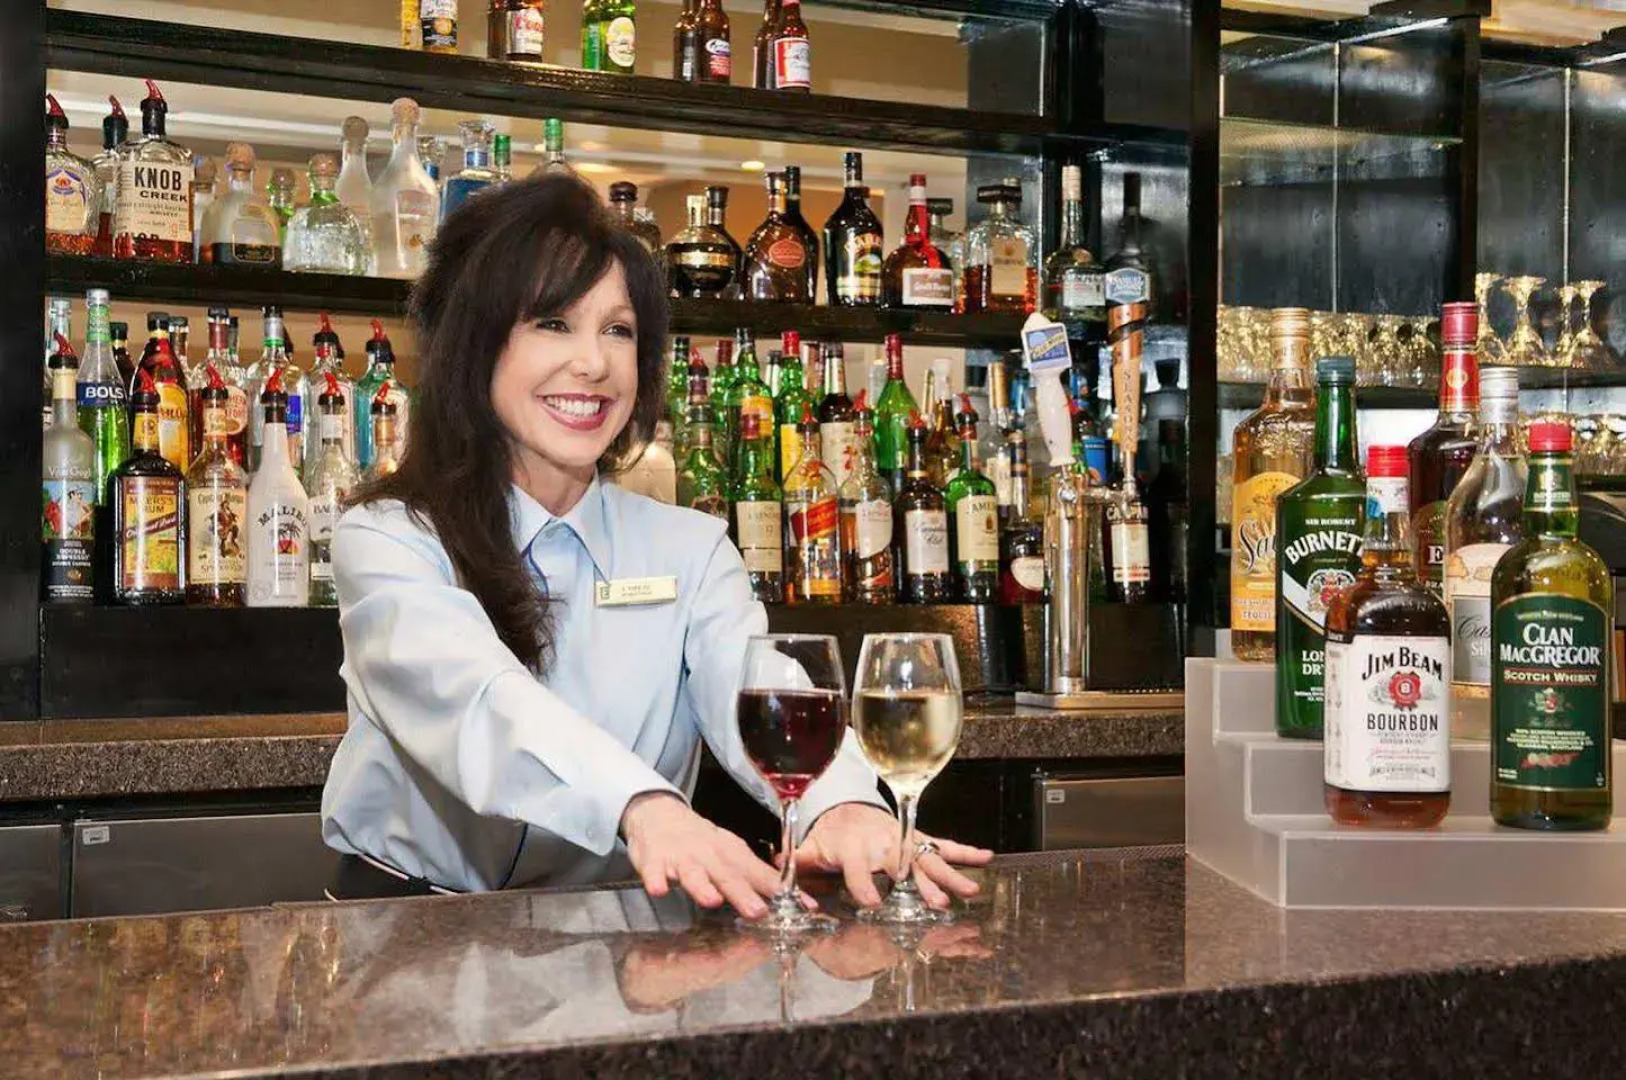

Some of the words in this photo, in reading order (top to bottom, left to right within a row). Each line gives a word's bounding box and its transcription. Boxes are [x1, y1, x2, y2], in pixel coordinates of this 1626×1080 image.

[134, 166, 182, 191] KNOB
[140, 191, 188, 202] CREEK
[85, 386, 124, 399] BOLS
[1242, 610, 1273, 620] TEQUI
[1522, 622, 1574, 646] CLAN
[1362, 653, 1395, 681] JIM
[1399, 646, 1443, 681] BEAM
[1500, 643, 1601, 668] MACGREGOR
[1302, 663, 1325, 676] DR
[1503, 669, 1551, 681] SCOTCH
[1553, 671, 1598, 683] WHISKY
[1367, 712, 1439, 731] BOURBON
